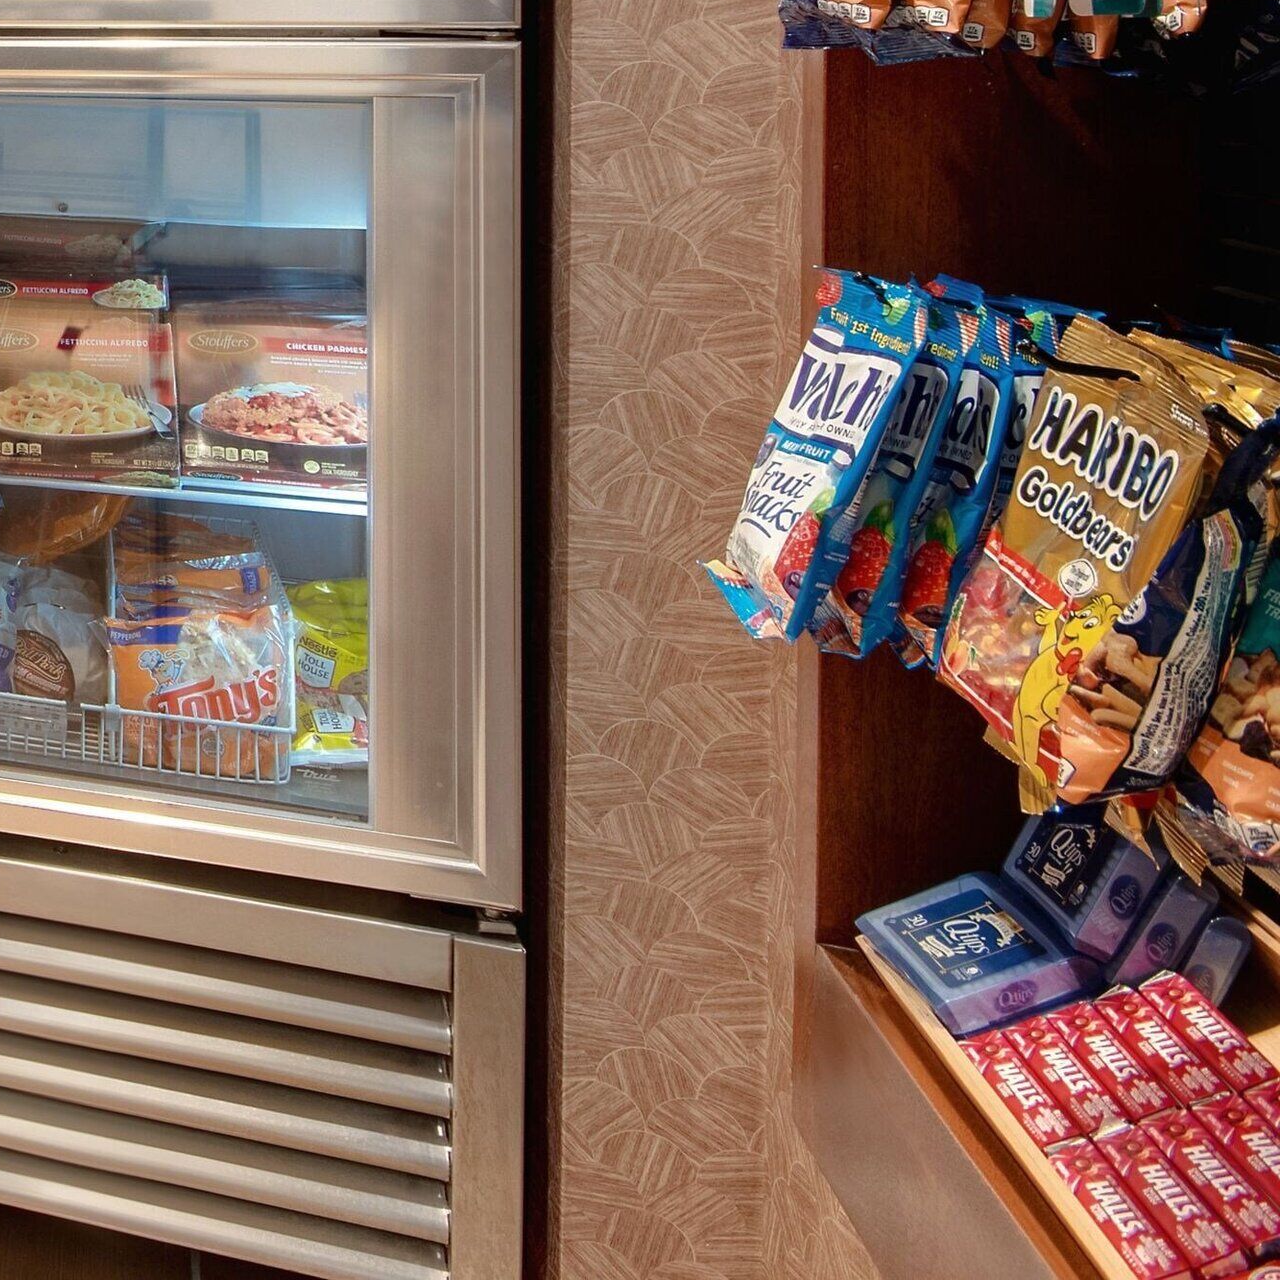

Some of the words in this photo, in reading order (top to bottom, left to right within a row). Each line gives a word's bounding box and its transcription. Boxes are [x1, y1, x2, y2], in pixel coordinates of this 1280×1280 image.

[58, 287, 89, 295] ALFREDO
[60, 338, 109, 347] FETTUCCINI
[109, 339, 149, 348] ALFREDO
[285, 342, 326, 352] CHICKEN
[799, 442, 832, 460] FRUIT
[1030, 386, 1178, 521] HARIBO
[756, 461, 814, 500] Fruit
[1019, 468, 1134, 571] Goldbears
[298, 659, 330, 679] HOUSE
[303, 652, 327, 670] TOLL
[994, 1061, 1045, 1110] HALLS
[1138, 1163, 1199, 1221] HALLS
[1183, 1143, 1247, 1202] HALLS
[1086, 1180, 1146, 1238] HALLS
